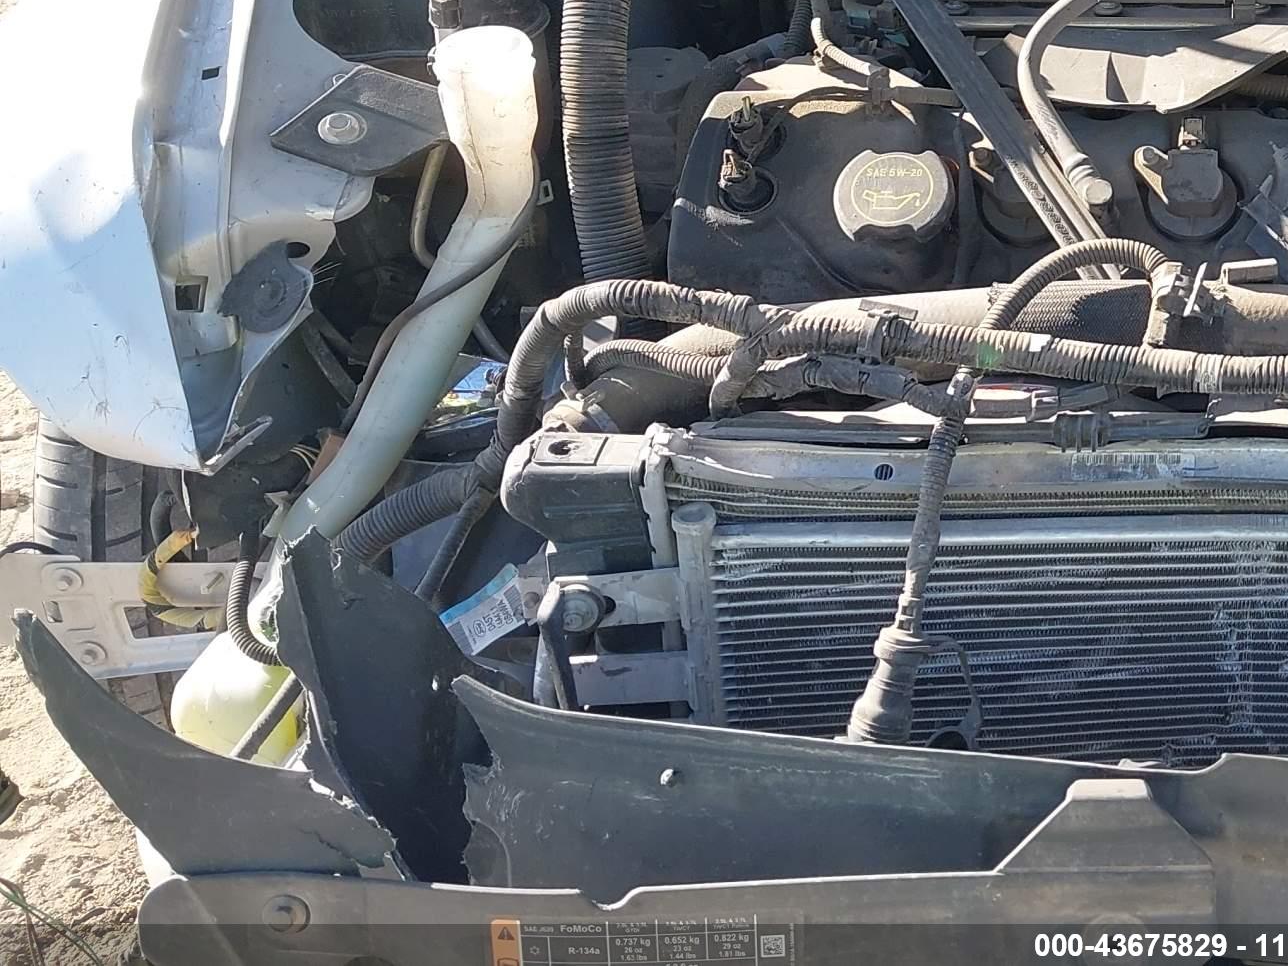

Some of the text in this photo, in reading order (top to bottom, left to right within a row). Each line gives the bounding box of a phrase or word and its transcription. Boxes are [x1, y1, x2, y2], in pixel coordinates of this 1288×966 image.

[866, 168, 923, 177] SAE 5W-20
[560, 924, 602, 933] FoMoCo
[615, 937, 651, 947] 0.737 kg
[664, 935, 700, 945] 0.652 kg
[738, 933, 749, 943] kg
[568, 946, 601, 955] R-134a
